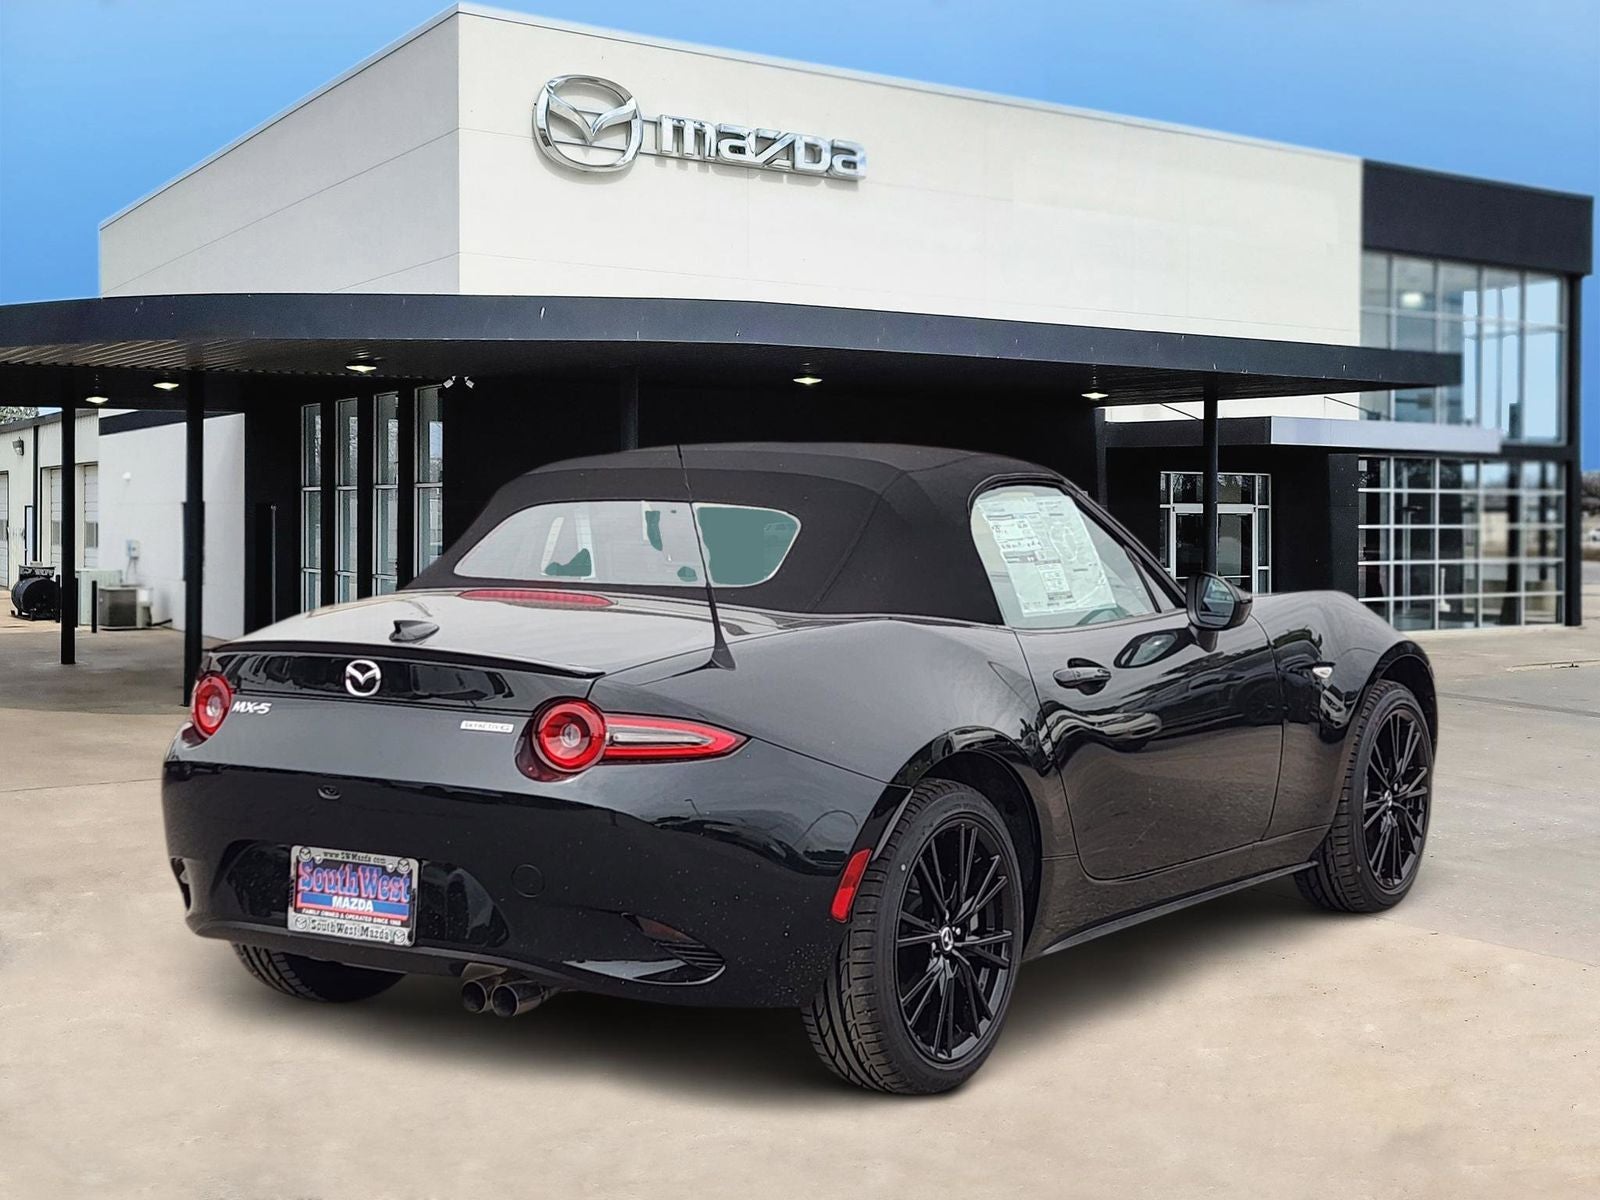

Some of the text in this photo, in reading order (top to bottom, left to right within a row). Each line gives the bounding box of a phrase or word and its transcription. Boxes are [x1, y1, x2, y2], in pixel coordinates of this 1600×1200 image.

[231, 701, 272, 714] MX-5
[332, 895, 374, 912] MAZDA
[360, 925, 389, 941] Mazda
